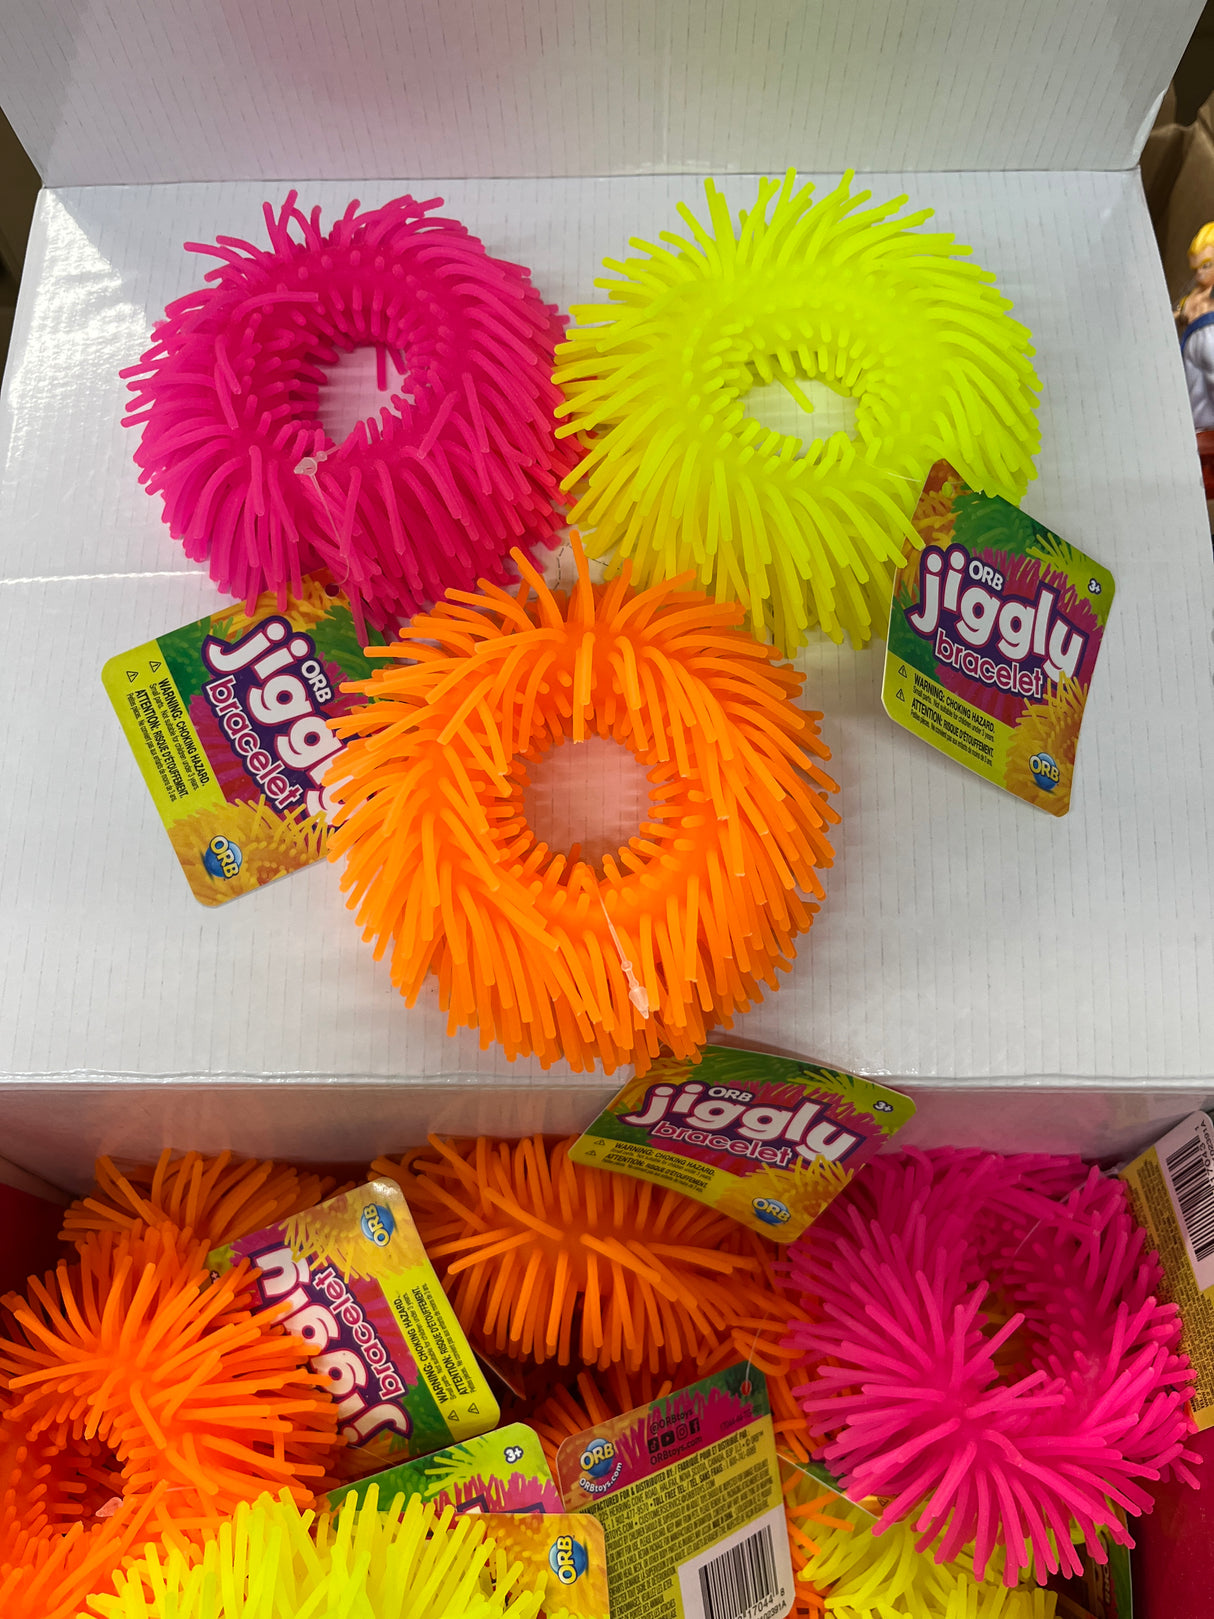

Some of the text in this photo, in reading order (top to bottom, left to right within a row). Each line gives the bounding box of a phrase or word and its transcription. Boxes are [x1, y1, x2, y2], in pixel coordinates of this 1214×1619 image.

[969, 560, 1004, 590] ORB
[1088, 579, 1101, 593] 3+
[911, 551, 1083, 683] jiggly
[301, 660, 332, 703] ORB
[935, 628, 1043, 698] bracelet
[911, 697, 942, 726] ATTENTION:
[943, 719, 958, 736] RISQUE
[914, 673, 995, 734] WARNING: CHOKING HAZARD.
[135, 687, 189, 798] ATTENTION: RISQUE D'ÉTOUFFEMENT.
[158, 677, 210, 786] WARNING: CHOKING HAZARD.
[206, 674, 303, 809] bracelet
[1029, 756, 1060, 784] ORB
[209, 835, 240, 878] ORB
[708, 1087, 752, 1102] ORB
[876, 1101, 892, 1112] 3+
[625, 1084, 857, 1163] jiggly
[651, 1121, 792, 1167] bracelet
[606, 1153, 644, 1166] ATTENTION:
[615, 1142, 717, 1175] WARNING: CHOKING HAZARD.
[364, 1203, 390, 1247] ORB
[753, 1198, 790, 1223] ORB
[313, 1268, 405, 1400] bracelet
[393, 1295, 448, 1404] WARNING: CHOKING HAZARD.
[433, 1331, 448, 1354] RISQUE
[441, 1353, 468, 1397] ATTENTION:
[650, 1409, 694, 1434] @ORBtoys
[504, 1446, 523, 1464] 3+
[580, 1443, 615, 1470] ORB
[650, 1436, 704, 1466] ORBtoys.com
[579, 1462, 623, 1494] ORBtoys.com
[557, 1535, 576, 1586] ORB
